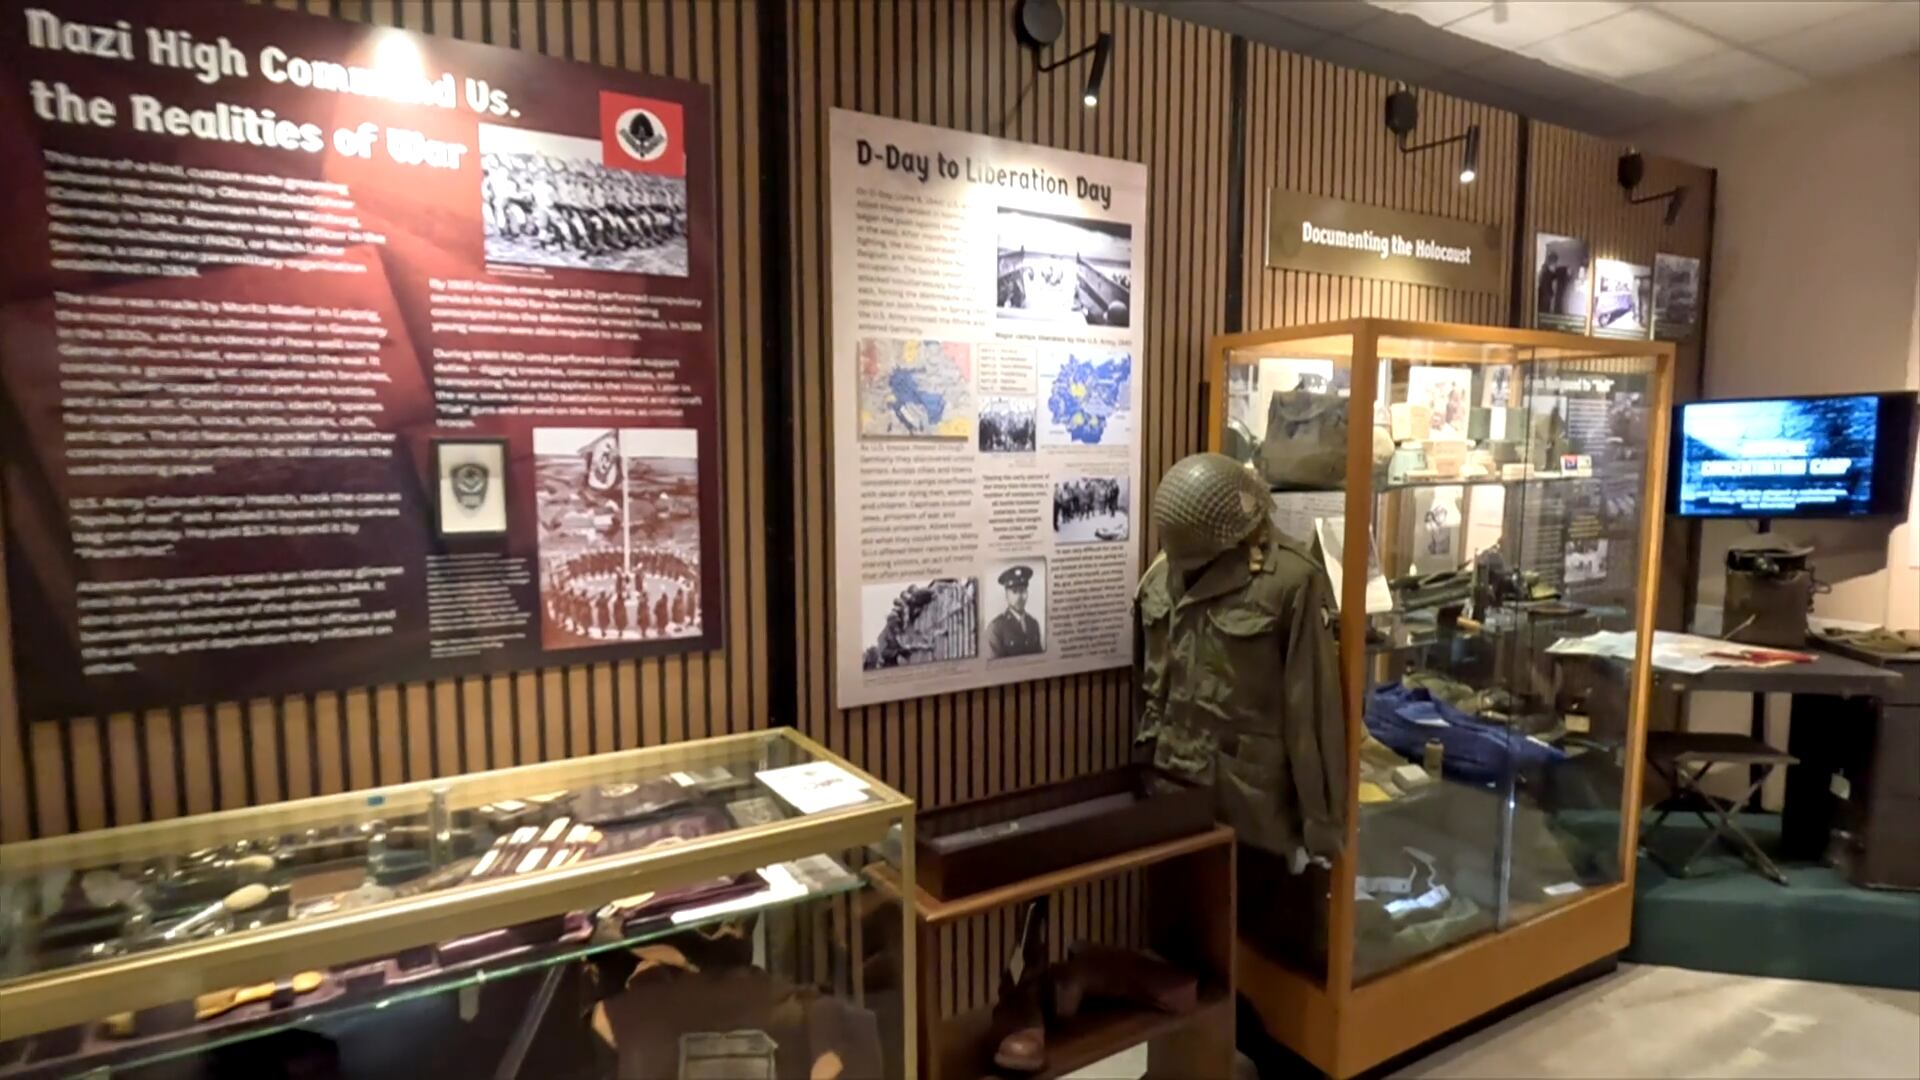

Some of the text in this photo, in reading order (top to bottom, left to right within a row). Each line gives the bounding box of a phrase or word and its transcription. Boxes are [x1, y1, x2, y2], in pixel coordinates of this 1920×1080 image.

[24, 9, 134, 60] Nazi
[146, 27, 247, 84] High
[260, 46, 456, 109] Commnd
[30, 80, 468, 170] the Realities of War
[856, 139, 1112, 210] D-Day to Liberation Day
[1302, 221, 1471, 264] Documenting the Holocaust
